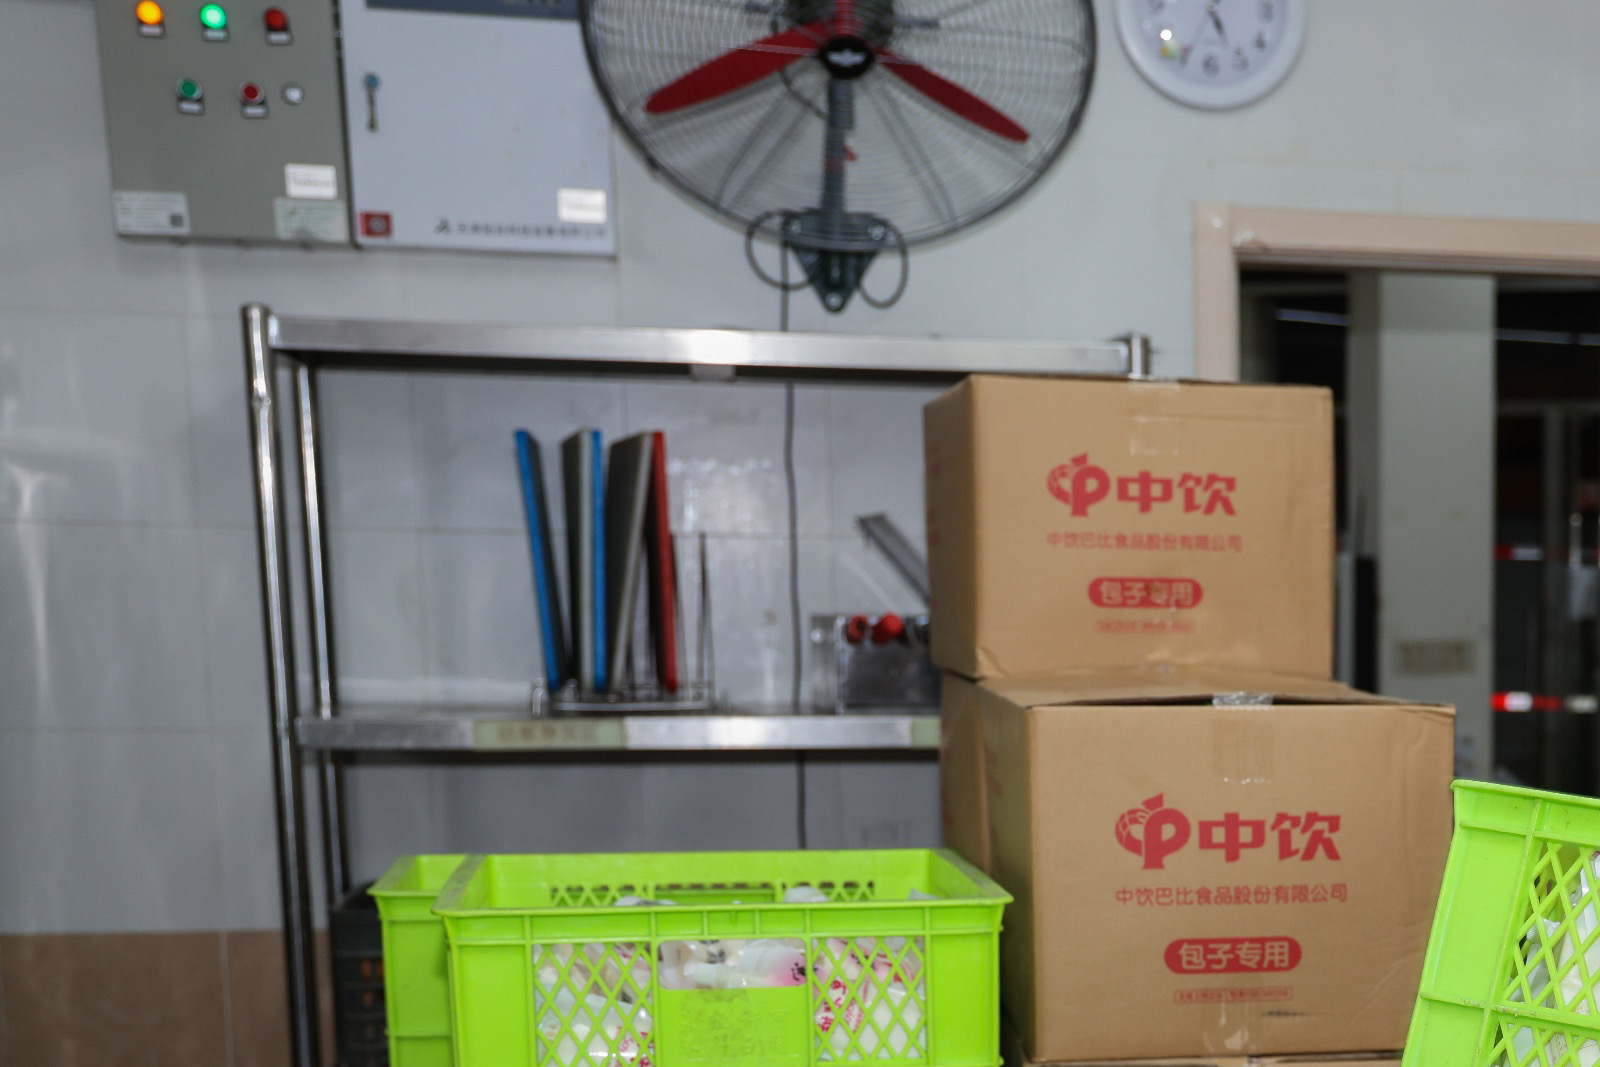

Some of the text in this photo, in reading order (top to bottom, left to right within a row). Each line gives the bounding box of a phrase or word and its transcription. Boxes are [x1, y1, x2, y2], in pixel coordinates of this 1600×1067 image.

[1115, 470, 1237, 516] 中饮
[1198, 811, 1343, 864] 中饮
[1115, 882, 1348, 907] 中饮巴比食品股份有限公司
[1178, 940, 1290, 971] 包子专用
